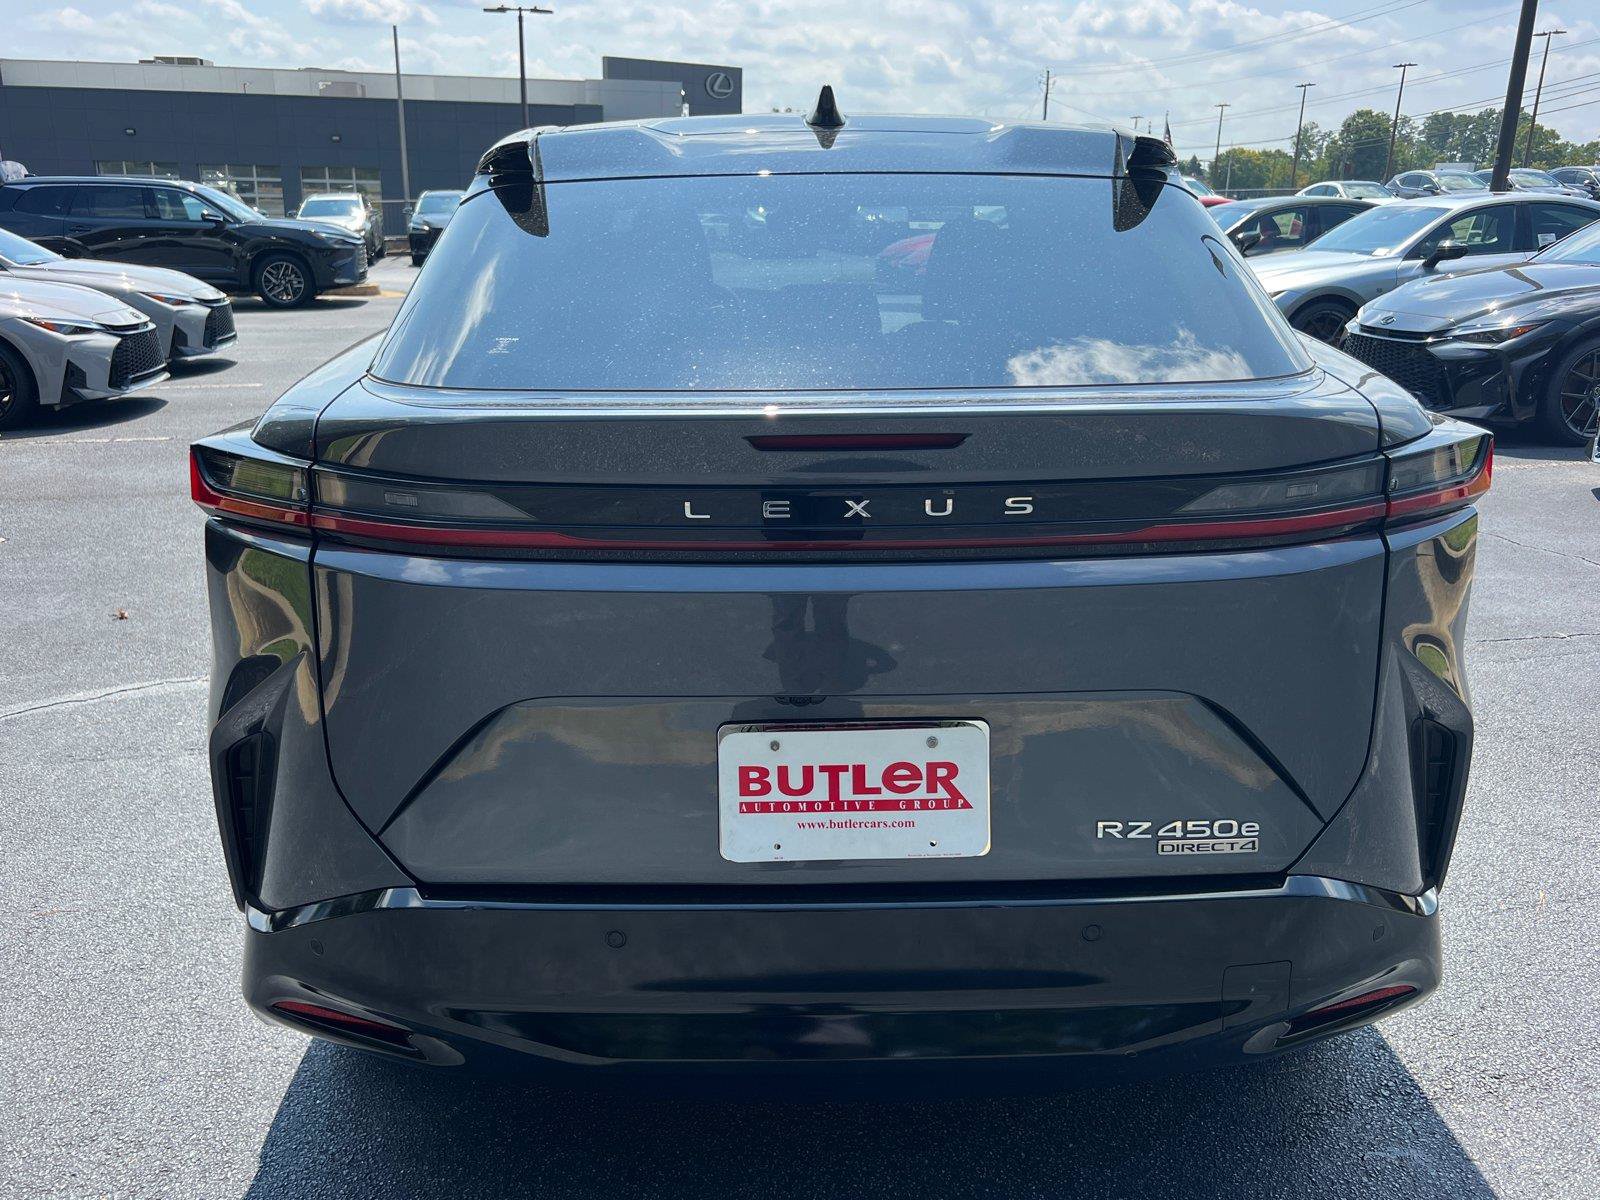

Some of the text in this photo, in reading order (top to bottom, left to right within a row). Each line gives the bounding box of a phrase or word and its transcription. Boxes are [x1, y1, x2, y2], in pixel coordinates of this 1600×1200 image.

[683, 496, 1034, 519] LEXUS
[740, 798, 966, 812] AUTOMOTIVE GROUP
[796, 818, 916, 830] www.butlercars.com
[1160, 840, 1257, 853] DIRECT4
